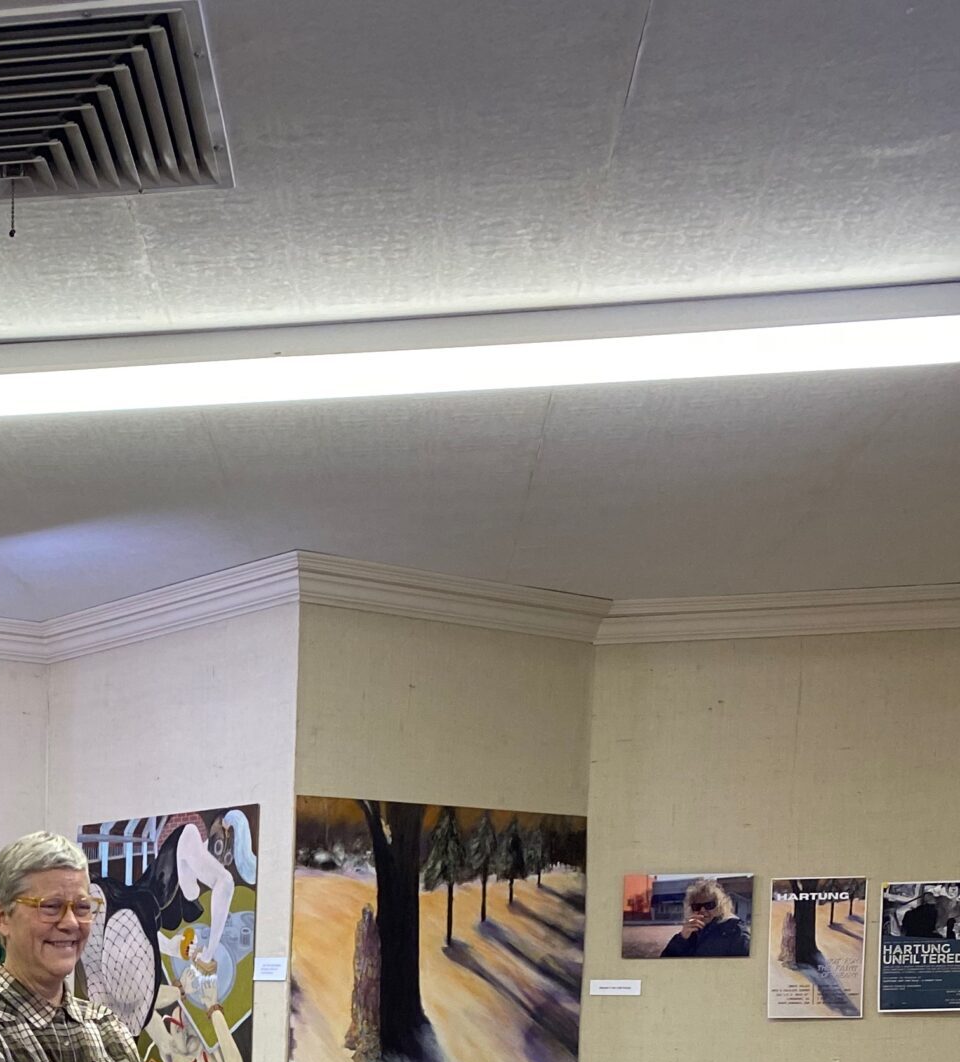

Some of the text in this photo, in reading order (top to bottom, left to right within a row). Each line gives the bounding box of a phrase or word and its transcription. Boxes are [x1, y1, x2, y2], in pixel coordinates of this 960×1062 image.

[776, 892, 849, 901] HARTUNG
[882, 943, 951, 955] HARTUNG
[882, 953, 960, 965] UNFILTERED
